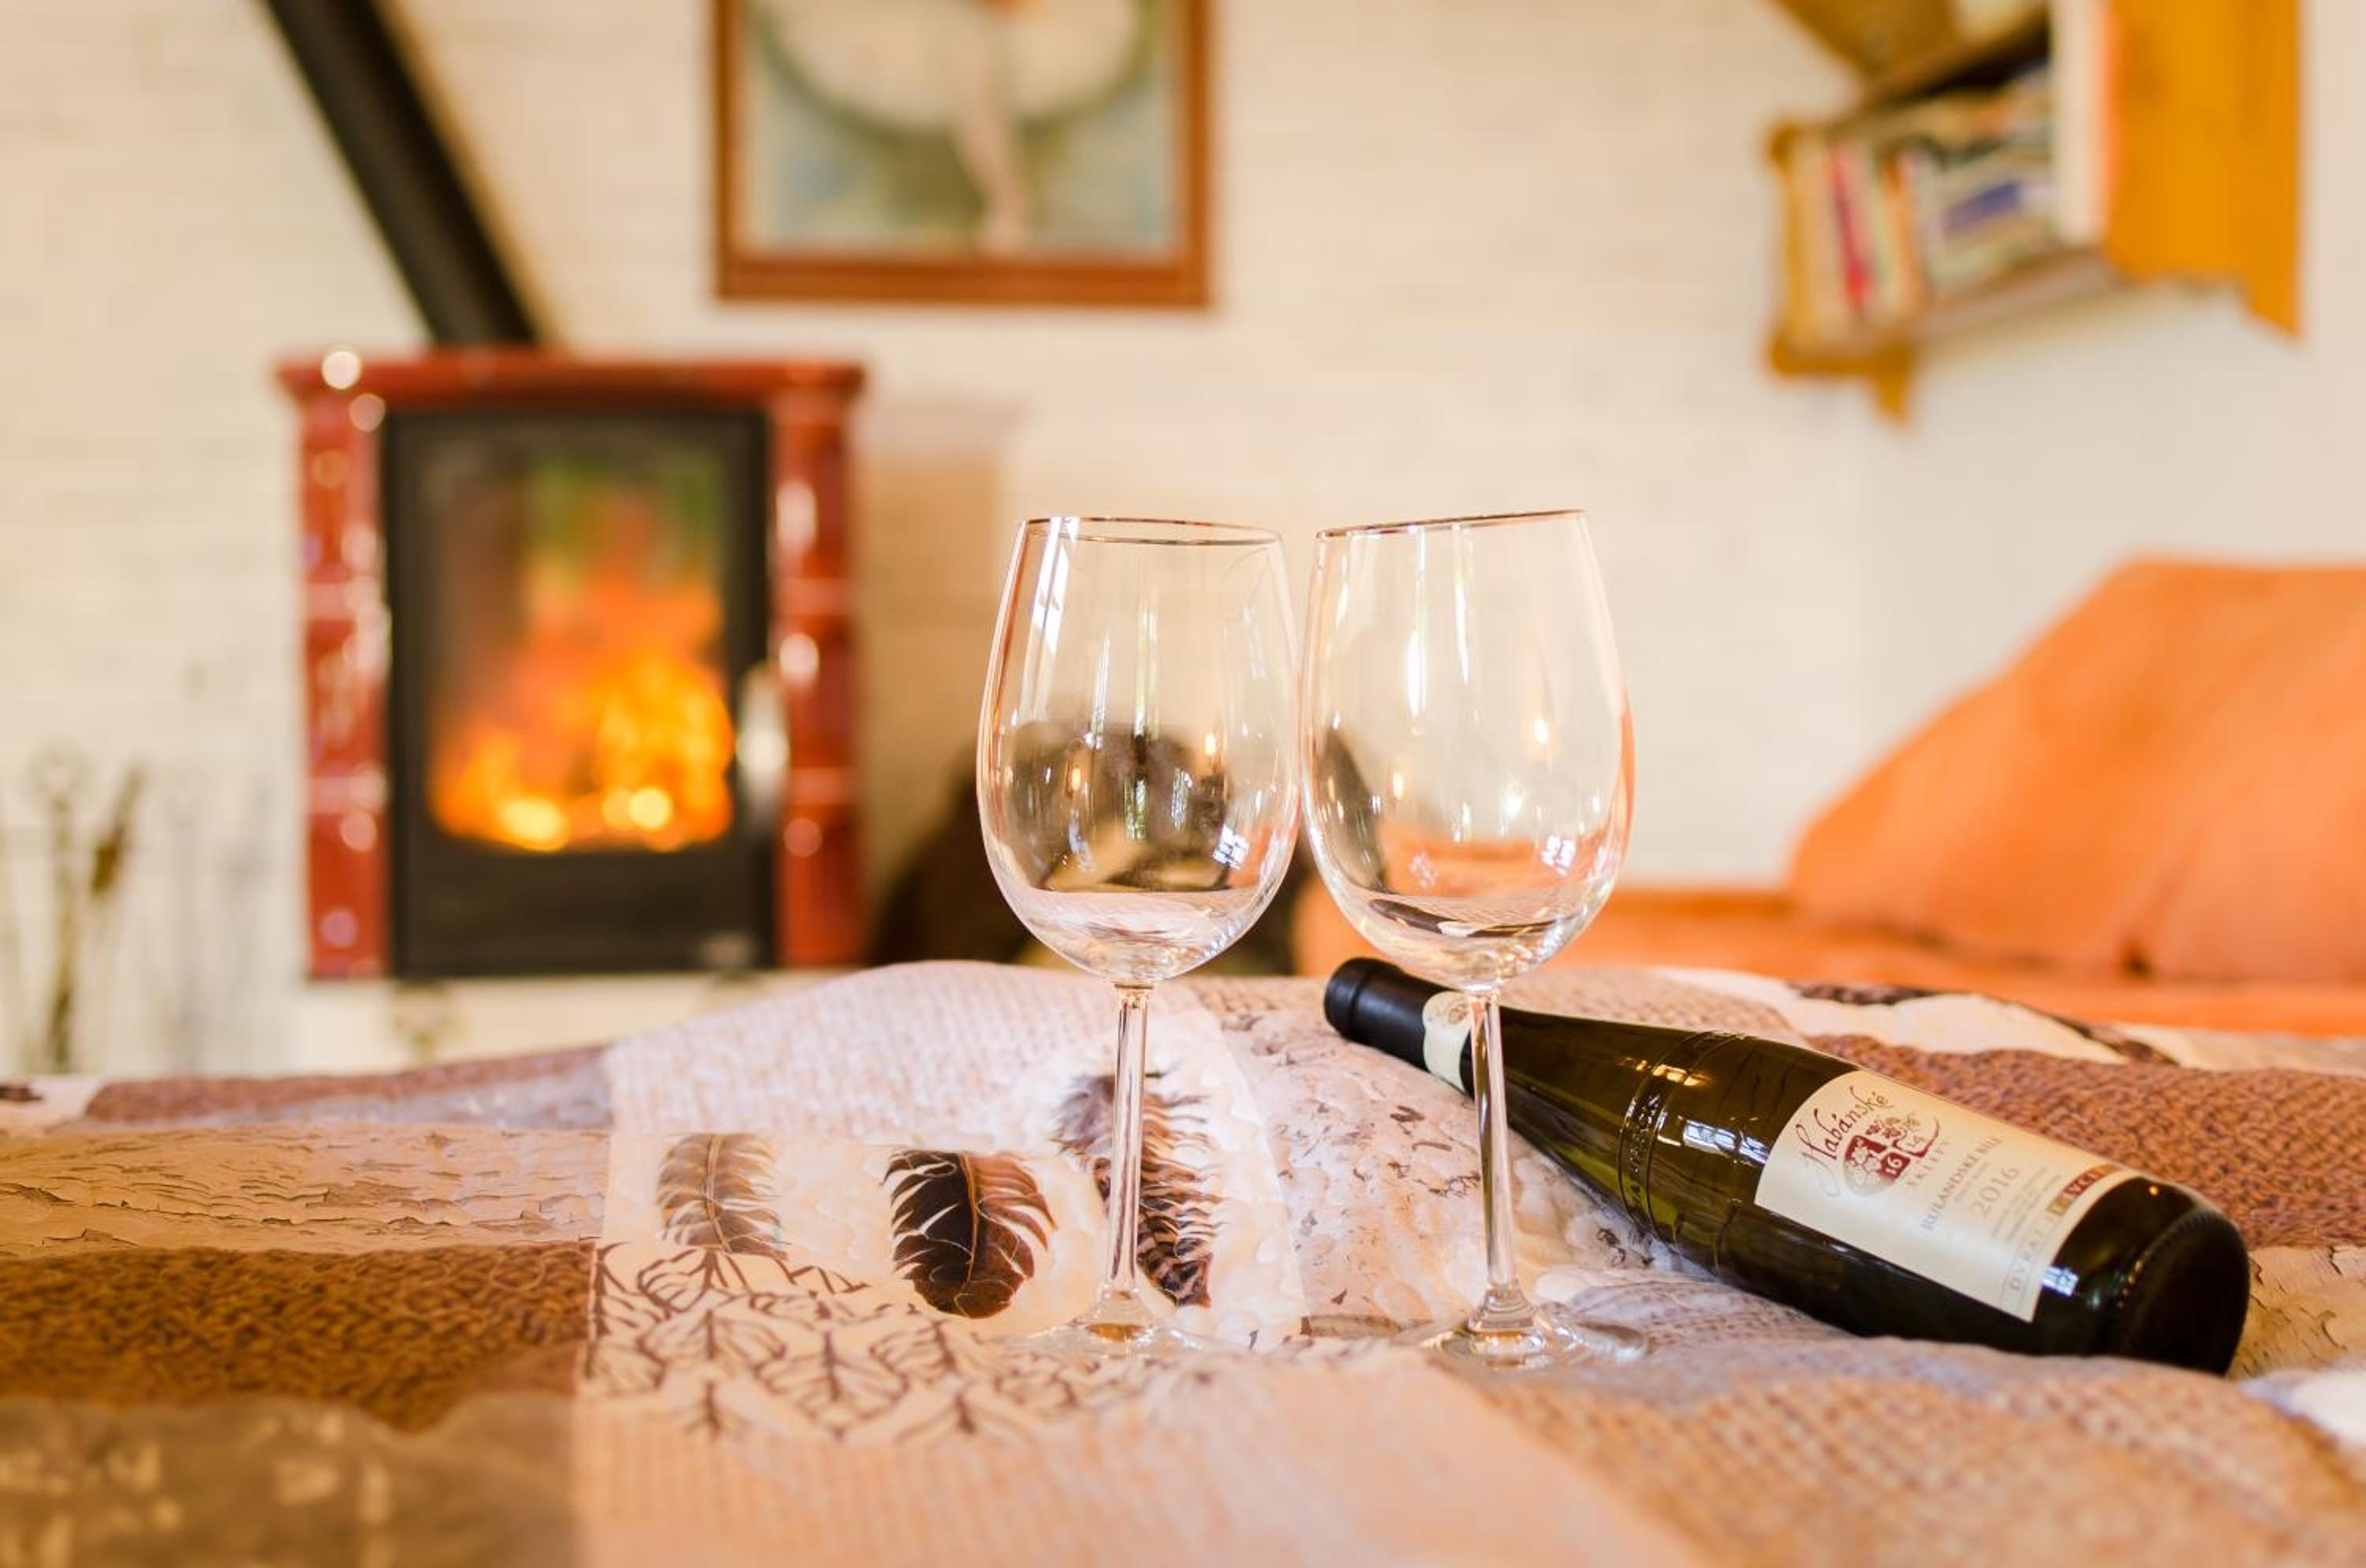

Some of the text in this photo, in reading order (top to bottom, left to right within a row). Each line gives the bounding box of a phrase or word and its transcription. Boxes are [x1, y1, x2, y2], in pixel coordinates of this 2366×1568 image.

[1796, 1085, 1893, 1197] Habánské
[1884, 1155, 1902, 1174] 16
[1969, 1166, 2020, 1218] 2016
